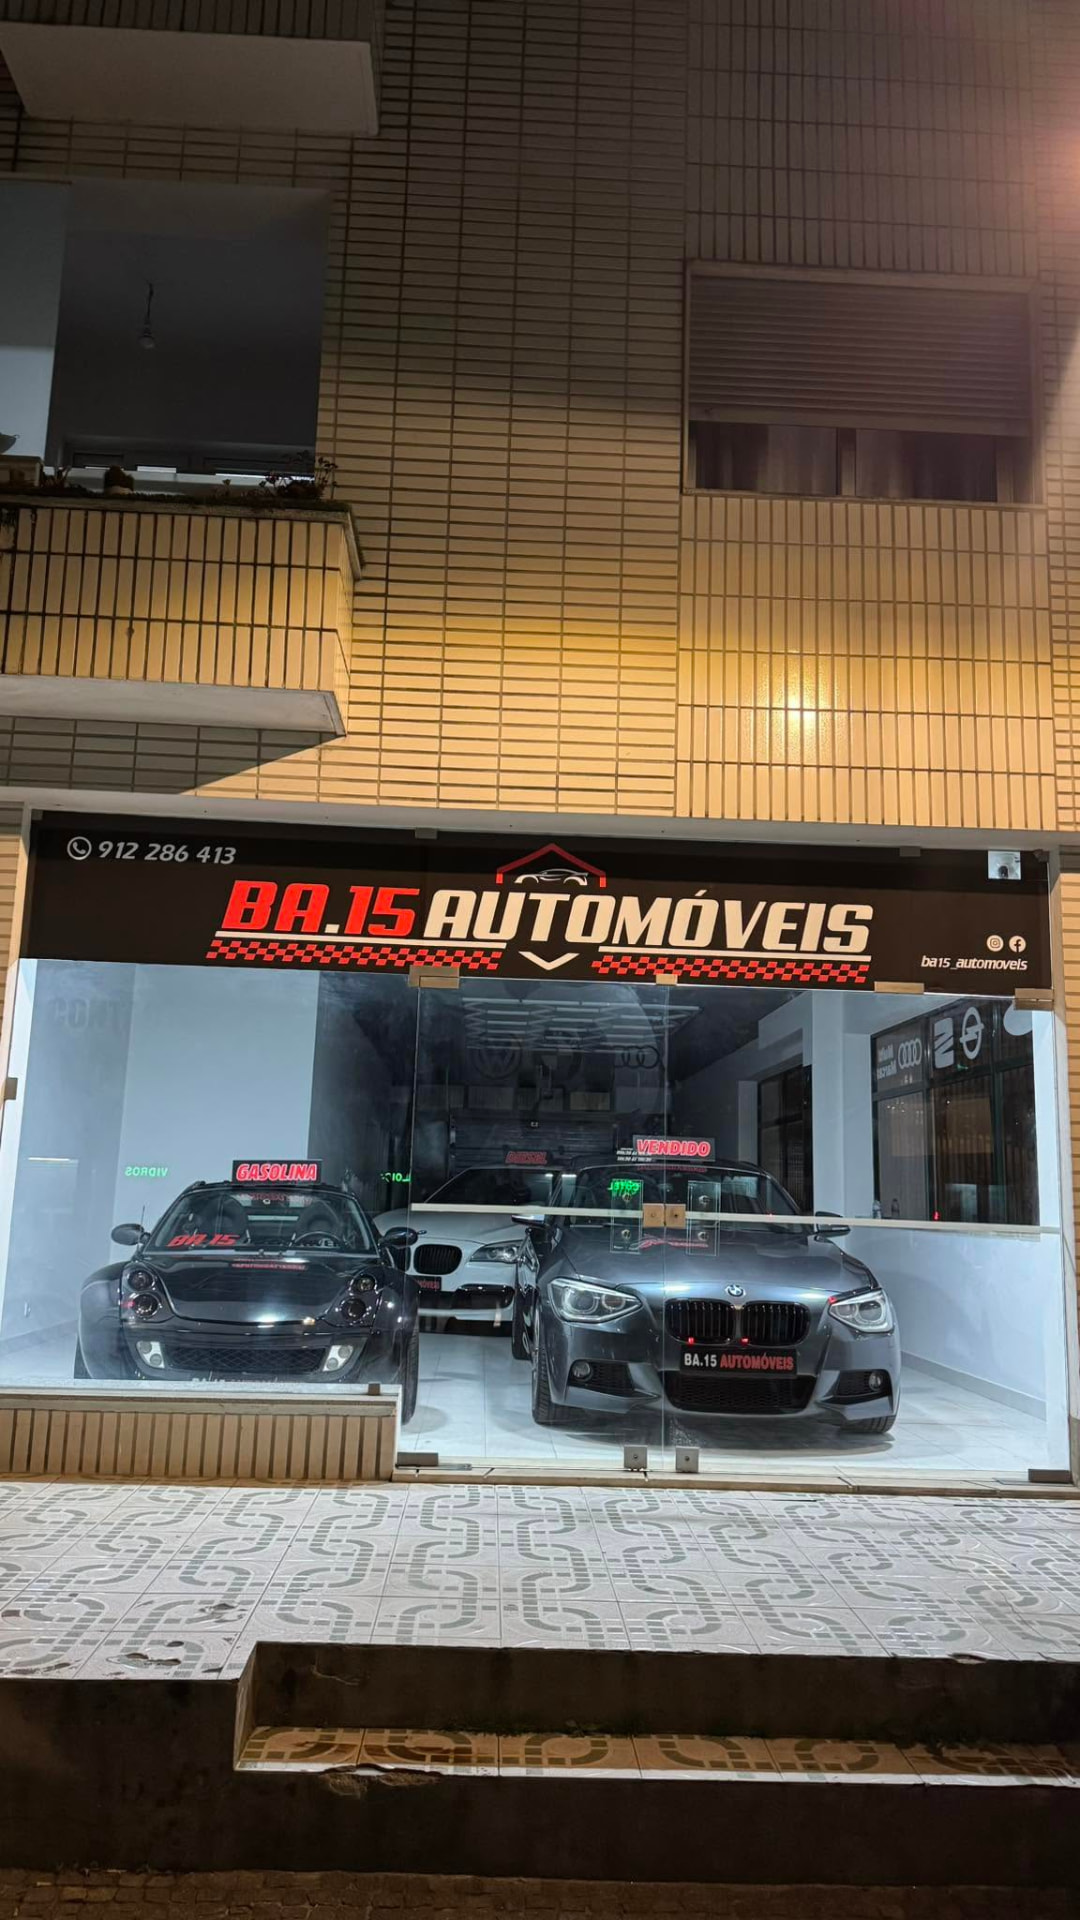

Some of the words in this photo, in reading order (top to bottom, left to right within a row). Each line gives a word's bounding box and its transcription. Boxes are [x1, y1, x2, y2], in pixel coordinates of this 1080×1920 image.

[98, 841, 139, 859] 912
[144, 843, 189, 862] 286
[196, 846, 237, 865] 413
[221, 879, 420, 937] BA.15
[423, 889, 874, 952] AUTOMÓVEIS
[920, 955, 1029, 971] ba15_automoveis
[636, 1138, 711, 1157] VENDIDO
[236, 1163, 317, 1181] GASOLINA
[684, 1353, 717, 1367] BA.15
[720, 1351, 795, 1370] AUTOMÓVEIS
